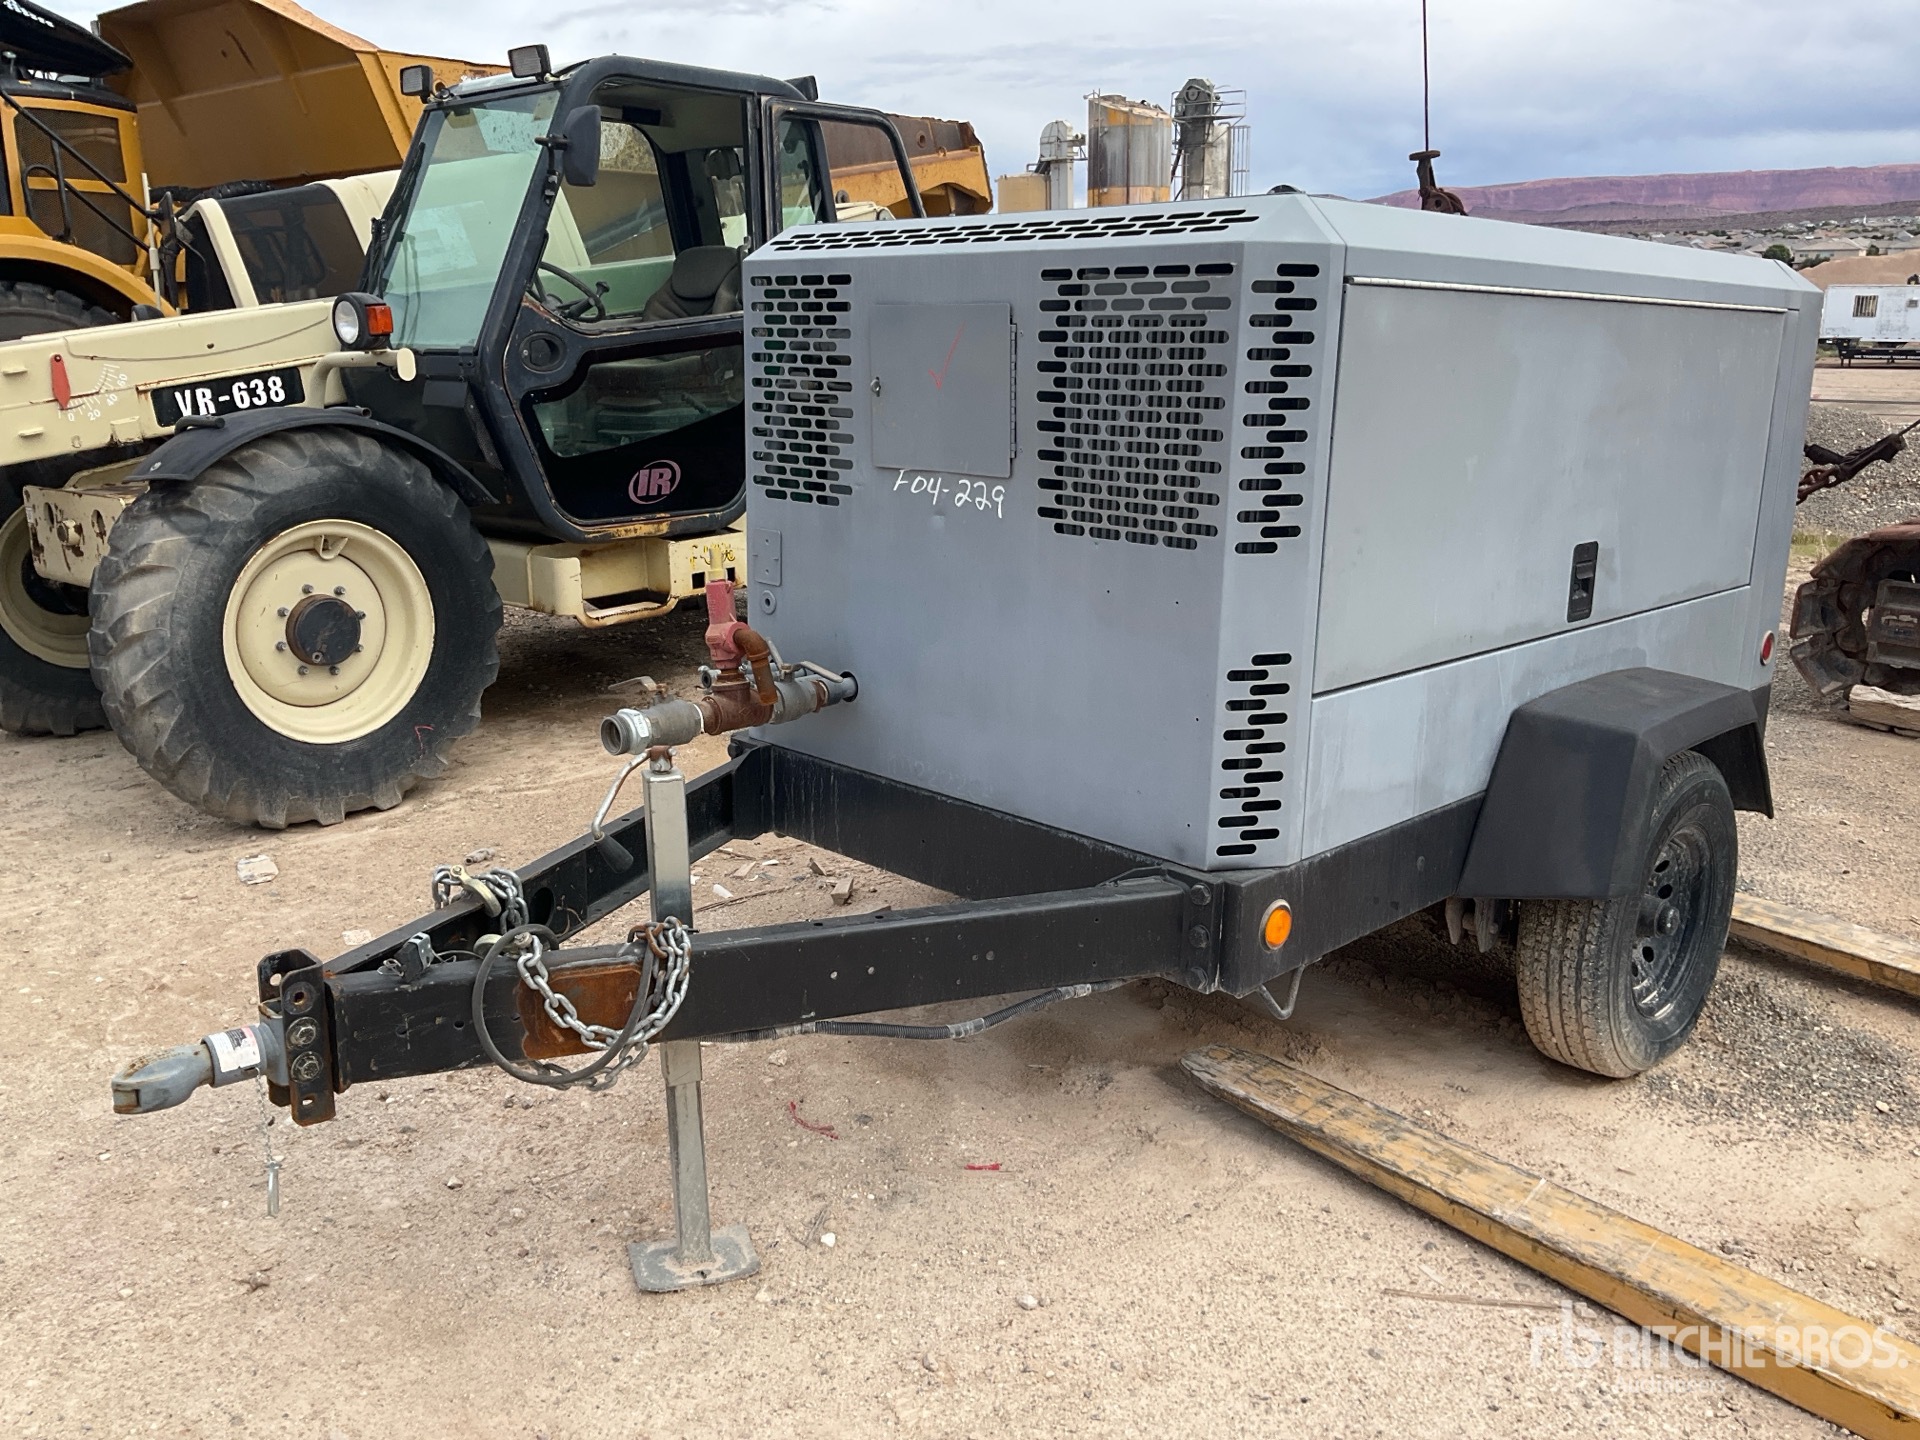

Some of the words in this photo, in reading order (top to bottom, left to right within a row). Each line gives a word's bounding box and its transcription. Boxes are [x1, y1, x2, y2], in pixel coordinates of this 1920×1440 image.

[106, 393, 118, 407] 40
[174, 375, 286, 417] VR-638
[67, 412, 75, 422] 0
[87, 408, 101, 421] 20
[637, 467, 672, 497] IR
[893, 469, 1006, 519] F04-229
